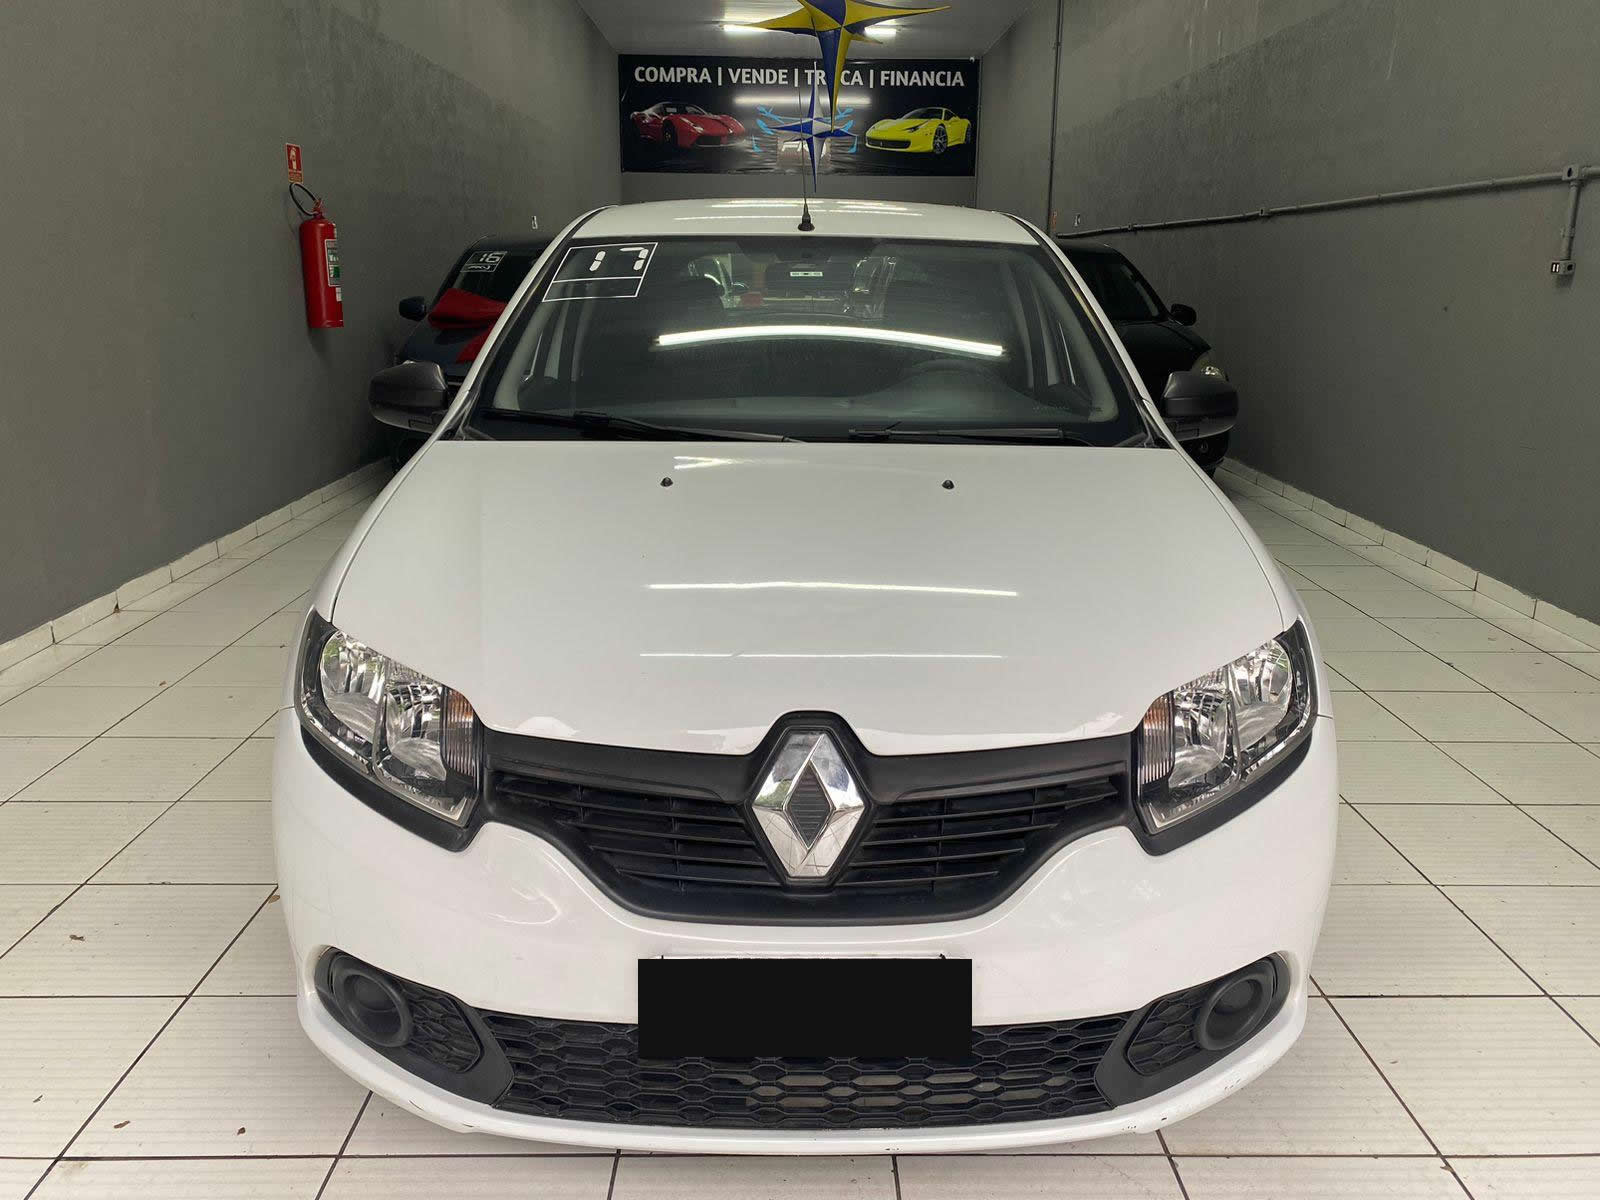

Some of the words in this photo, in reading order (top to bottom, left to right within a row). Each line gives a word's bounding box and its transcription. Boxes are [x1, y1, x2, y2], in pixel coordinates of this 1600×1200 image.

[634, 66, 712, 83] COMPRA
[728, 68, 788, 85] VENDE
[804, 69, 864, 86] TRCA
[880, 71, 965, 87] FINANCIA
[479, 252, 503, 263] 16
[589, 246, 649, 272] 17
